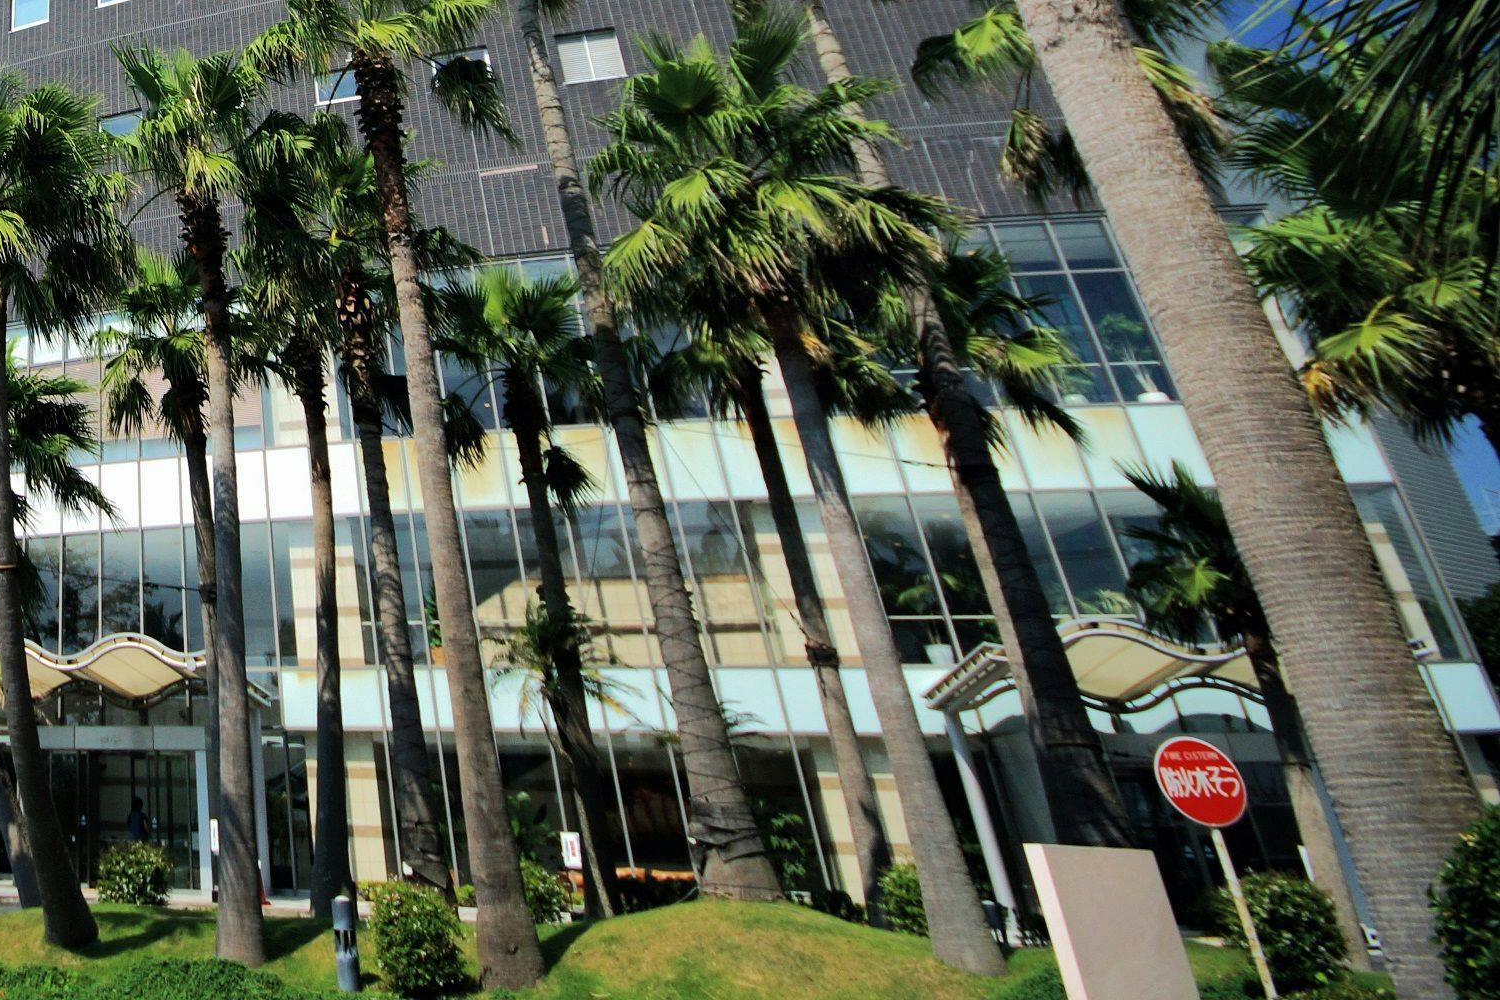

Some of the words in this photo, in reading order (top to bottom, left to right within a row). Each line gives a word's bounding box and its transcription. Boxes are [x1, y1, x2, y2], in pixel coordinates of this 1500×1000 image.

[1160, 766, 1240, 798] 防火水そう
